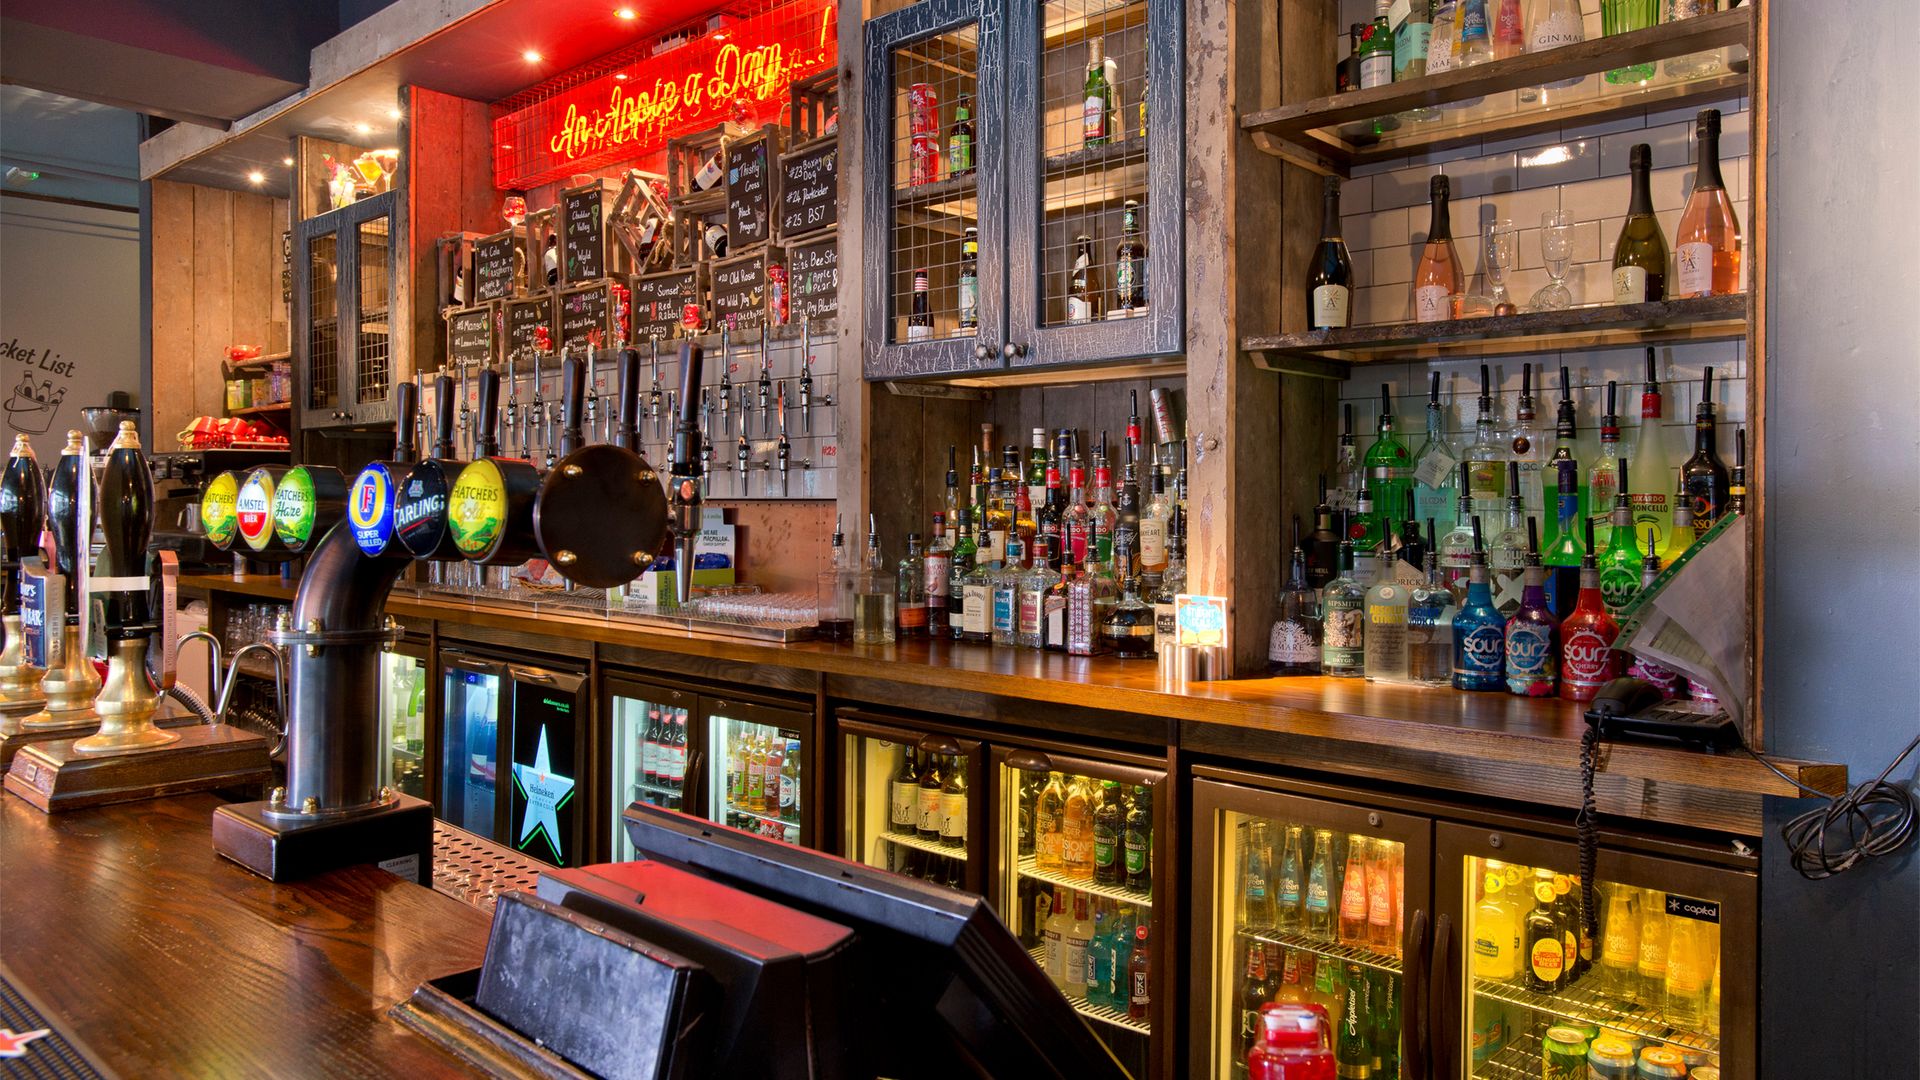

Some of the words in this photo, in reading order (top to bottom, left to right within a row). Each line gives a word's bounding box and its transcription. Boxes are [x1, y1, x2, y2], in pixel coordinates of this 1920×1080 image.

[1538, 35, 1559, 44] GIN
[739, 160, 760, 178] Thistly
[789, 165, 803, 180] #23
[803, 170, 817, 185] Dog
[745, 180, 760, 193] Cross
[569, 199, 580, 209] #13
[786, 190, 801, 204] #24
[572, 210, 591, 220] Cheddar
[738, 205, 751, 220] Black
[785, 213, 802, 228] #25
[808, 205, 825, 224] BS7
[576, 222, 591, 233] Valley
[810, 251, 824, 267] Bee
[582, 265, 596, 277] Wood
[730, 270, 740, 285] Old
[740, 269, 756, 282] Rosie
[813, 270, 831, 283] Apple
[642, 282, 654, 292] #15
[657, 283, 680, 297] Sunset
[813, 281, 831, 293] Pear
[638, 304, 650, 313] #16
[658, 298, 672, 311] Red
[726, 294, 738, 307] Wild
[658, 306, 682, 321] Rabbit
[638, 326, 649, 335] #17
[649, 324, 667, 339] Crazy
[39, 349, 76, 377] List
[1592, 473, 1616, 487] AGWA
[239, 499, 265, 511] AMSTEL
[361, 484, 375, 513] F
[1419, 496, 1447, 504] BLOOM
[275, 502, 301, 518] Haze
[244, 514, 258, 523] BIER
[357, 529, 379, 540] SUPER
[357, 537, 382, 547] CHILLED
[1369, 605, 1406, 615] ABSOLUT
[529, 784, 555, 799] Heineken
[529, 799, 543, 808] EXTRA
[543, 802, 555, 812] COLD
[1684, 904, 1716, 917] capital
[1136, 974, 1145, 994] WKD
[1345, 987, 1356, 1037] Appletiser
